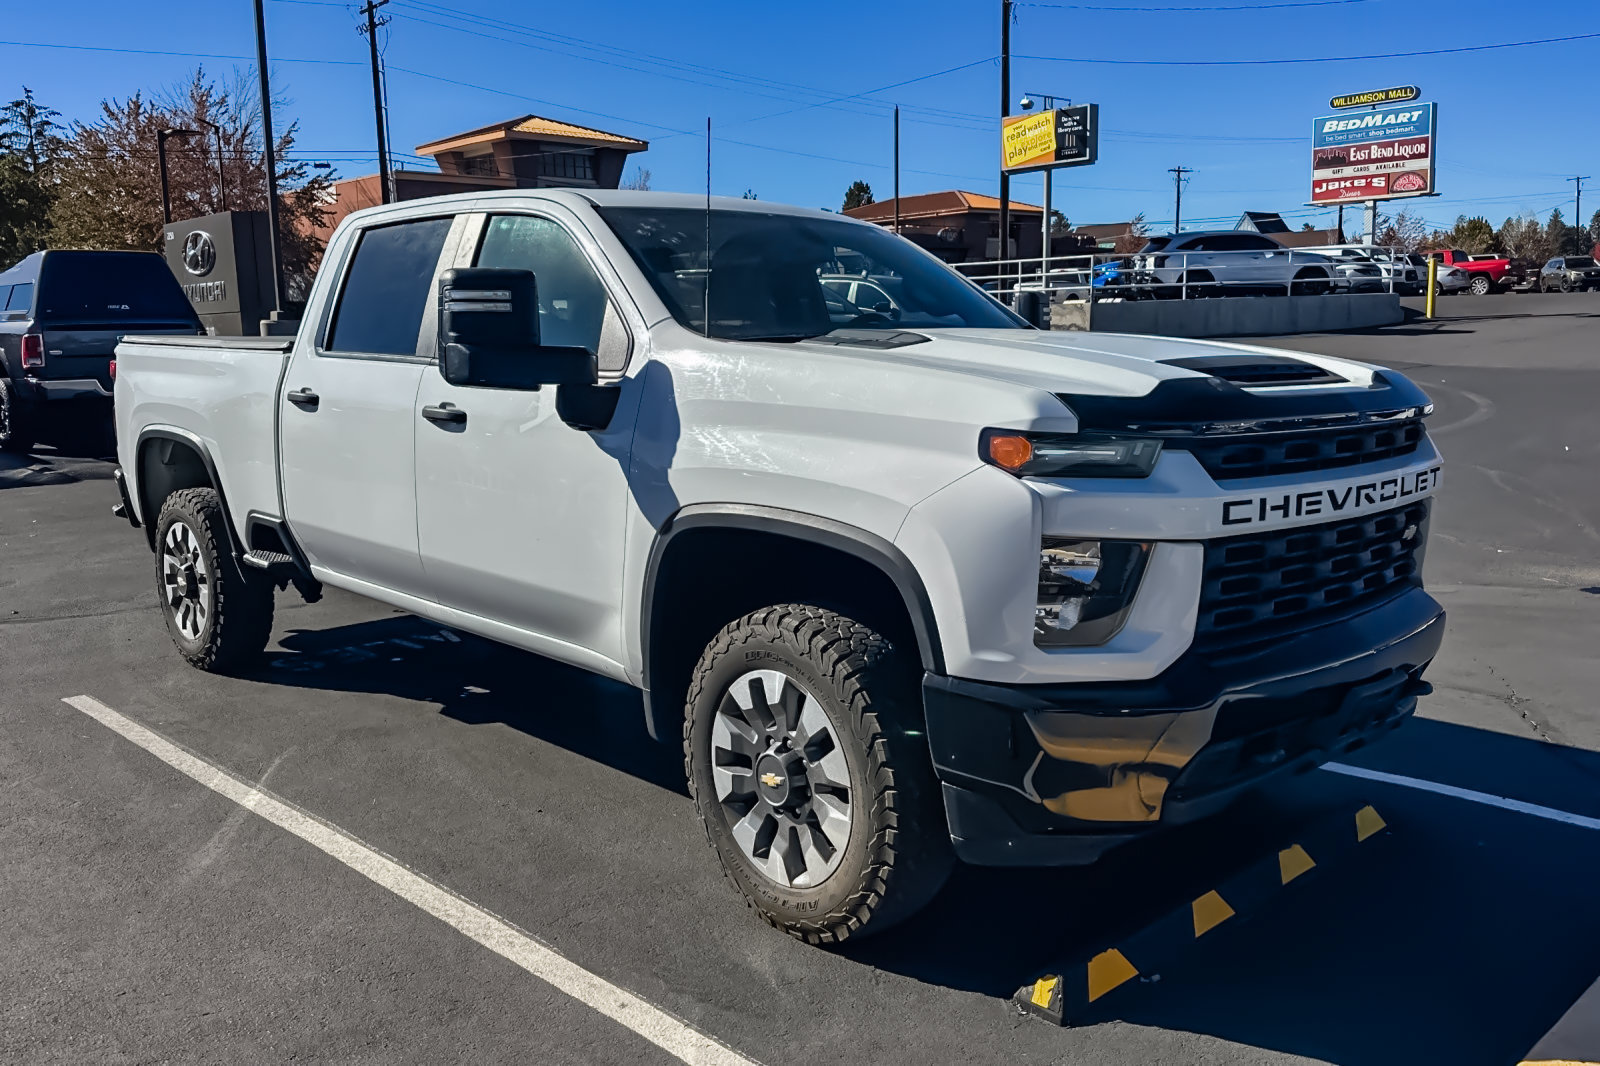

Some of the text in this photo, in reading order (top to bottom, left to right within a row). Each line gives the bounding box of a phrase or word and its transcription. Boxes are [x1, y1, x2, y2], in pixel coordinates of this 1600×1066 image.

[1333, 88, 1413, 107] WILLIAMSON MALL
[1027, 117, 1051, 131] watch
[1006, 126, 1027, 142] read
[1020, 131, 1052, 148] explore
[1008, 145, 1028, 162] play
[1028, 138, 1053, 152] and more
[1350, 142, 1426, 161] EAST BEND LIQUOR
[1375, 162, 1406, 171] AVAILABLE
[1338, 189, 1361, 198] Diner
[182, 280, 225, 302] YUNDAI
[1221, 466, 1441, 526] CHEVROLET
